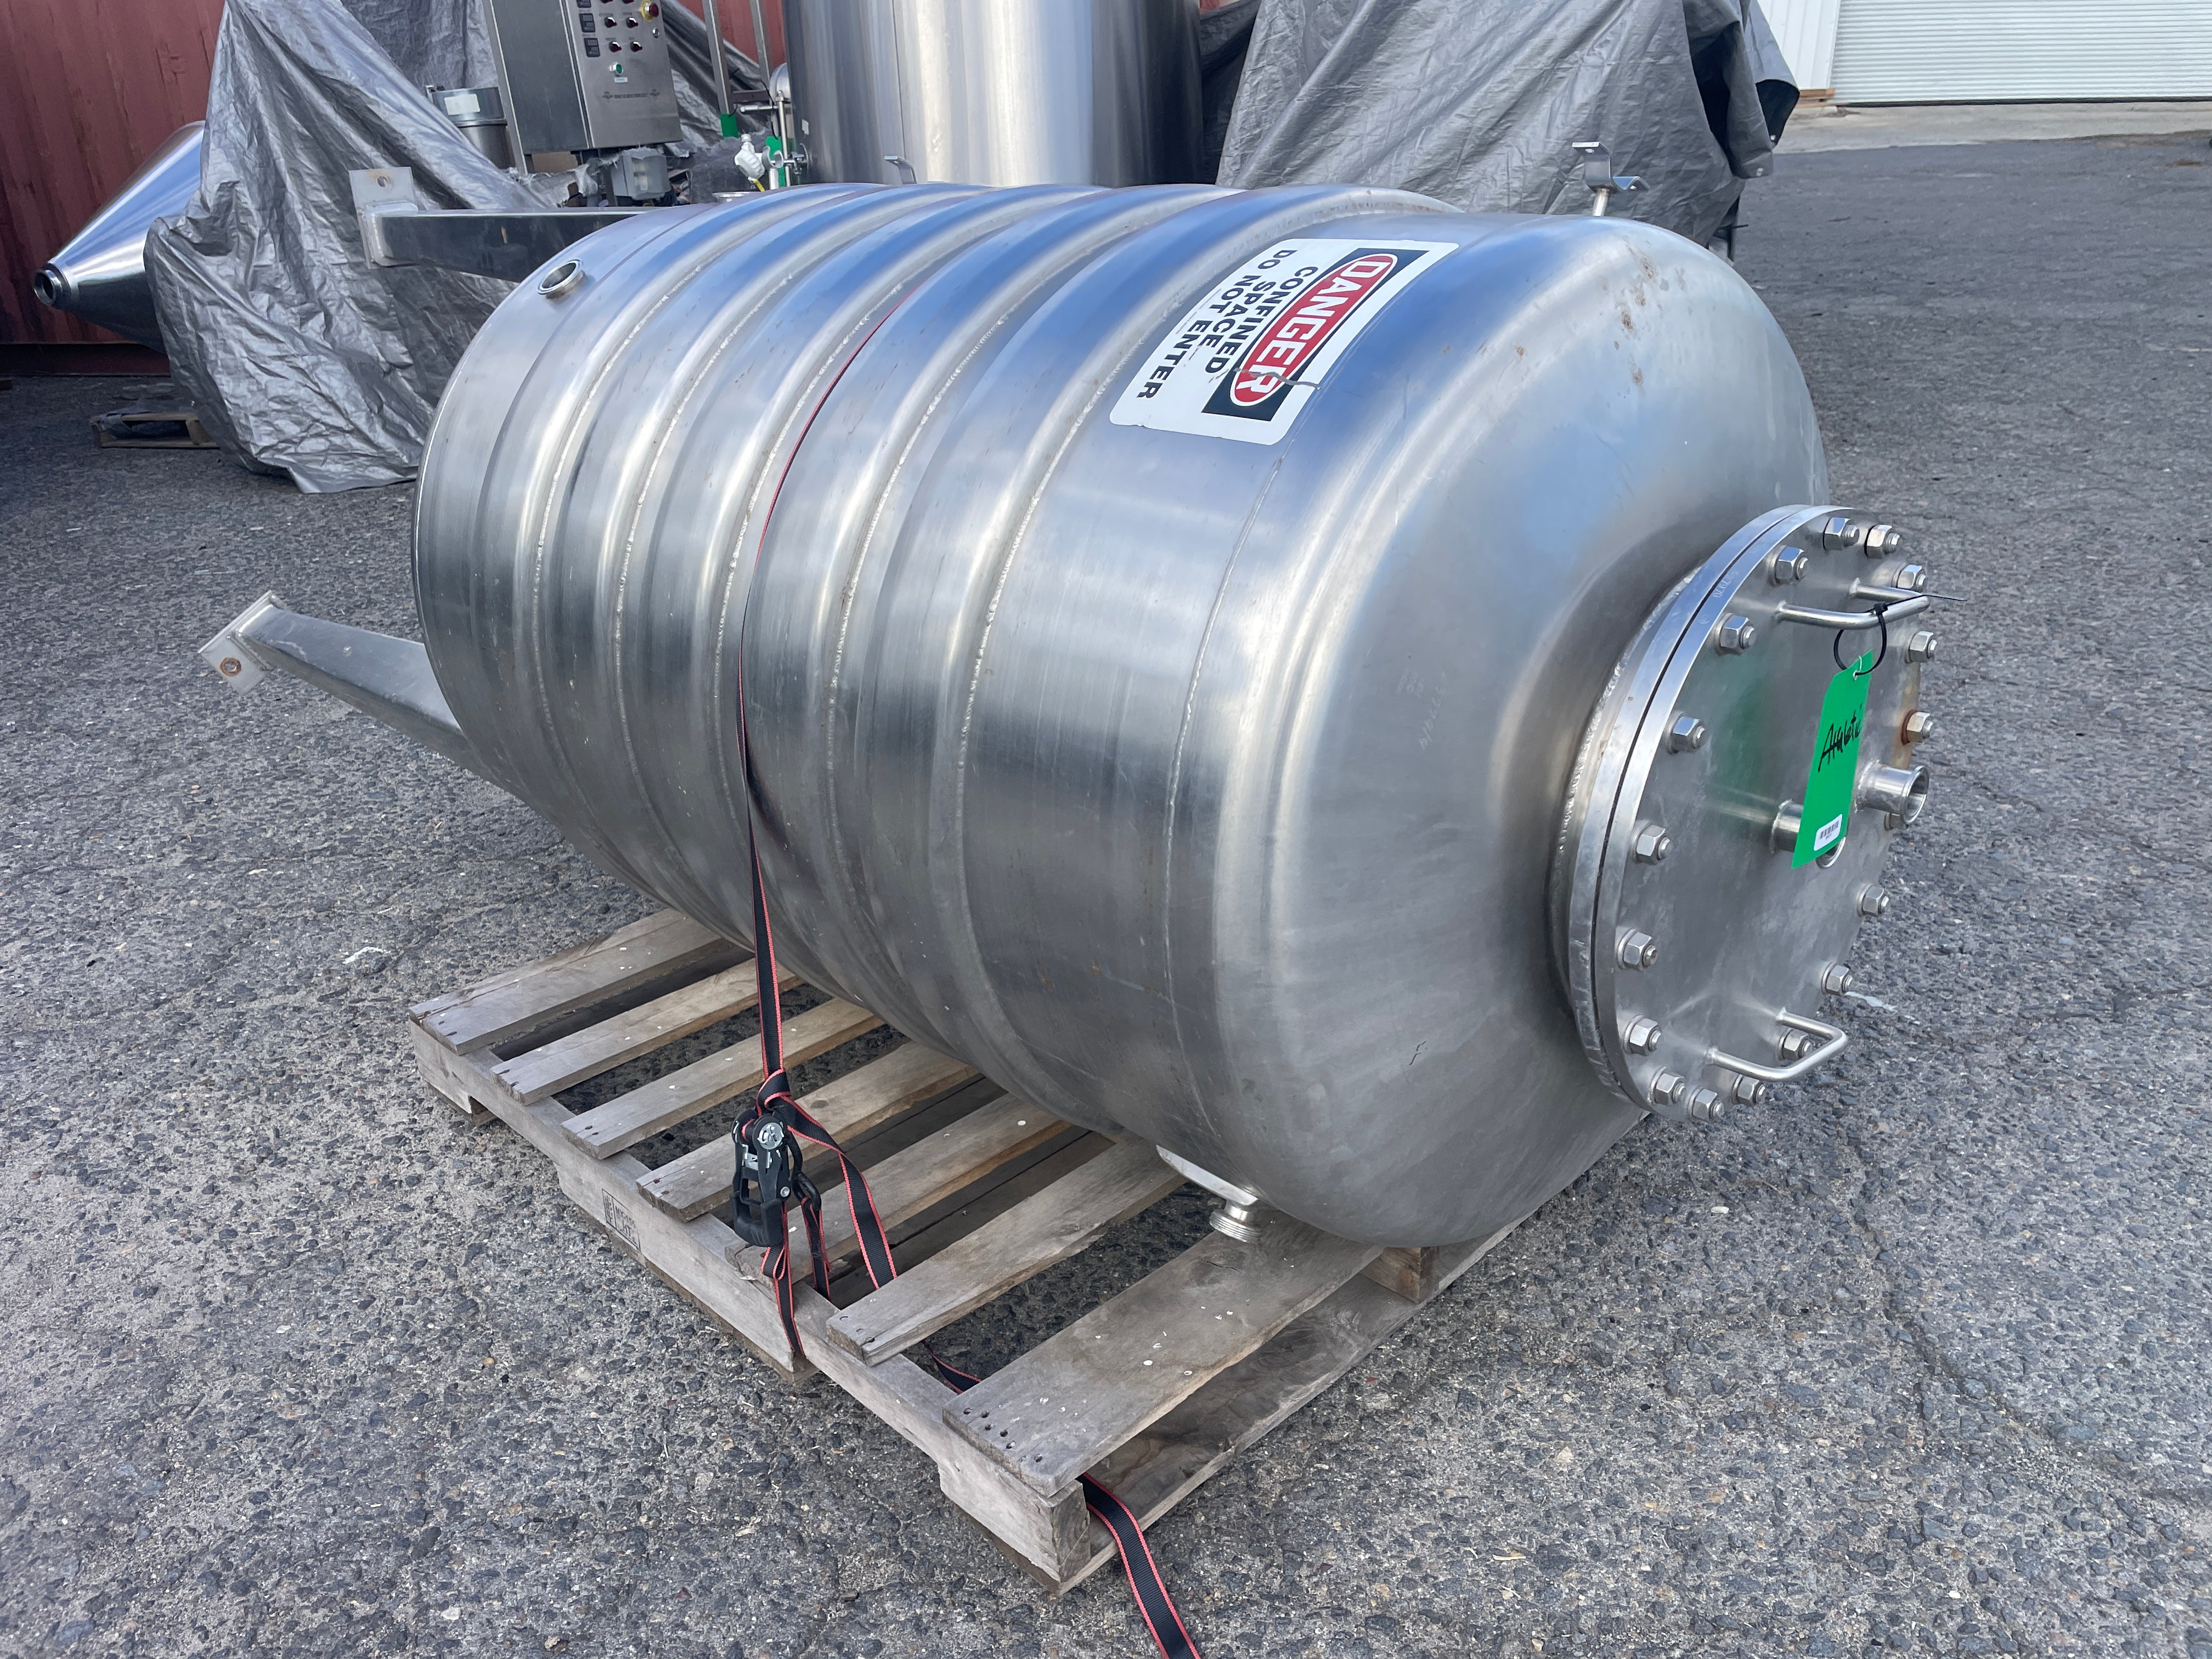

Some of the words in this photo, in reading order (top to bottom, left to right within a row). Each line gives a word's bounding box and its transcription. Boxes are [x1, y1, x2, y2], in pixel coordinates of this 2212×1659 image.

[1209, 275, 1262, 314] NOT
[1257, 250, 1298, 270] DO
[1200, 281, 1275, 348] SPACE
[1205, 266, 1319, 374] CONFINED
[1236, 261, 1393, 393] DANGER
[1136, 320, 1214, 398] ENTER
